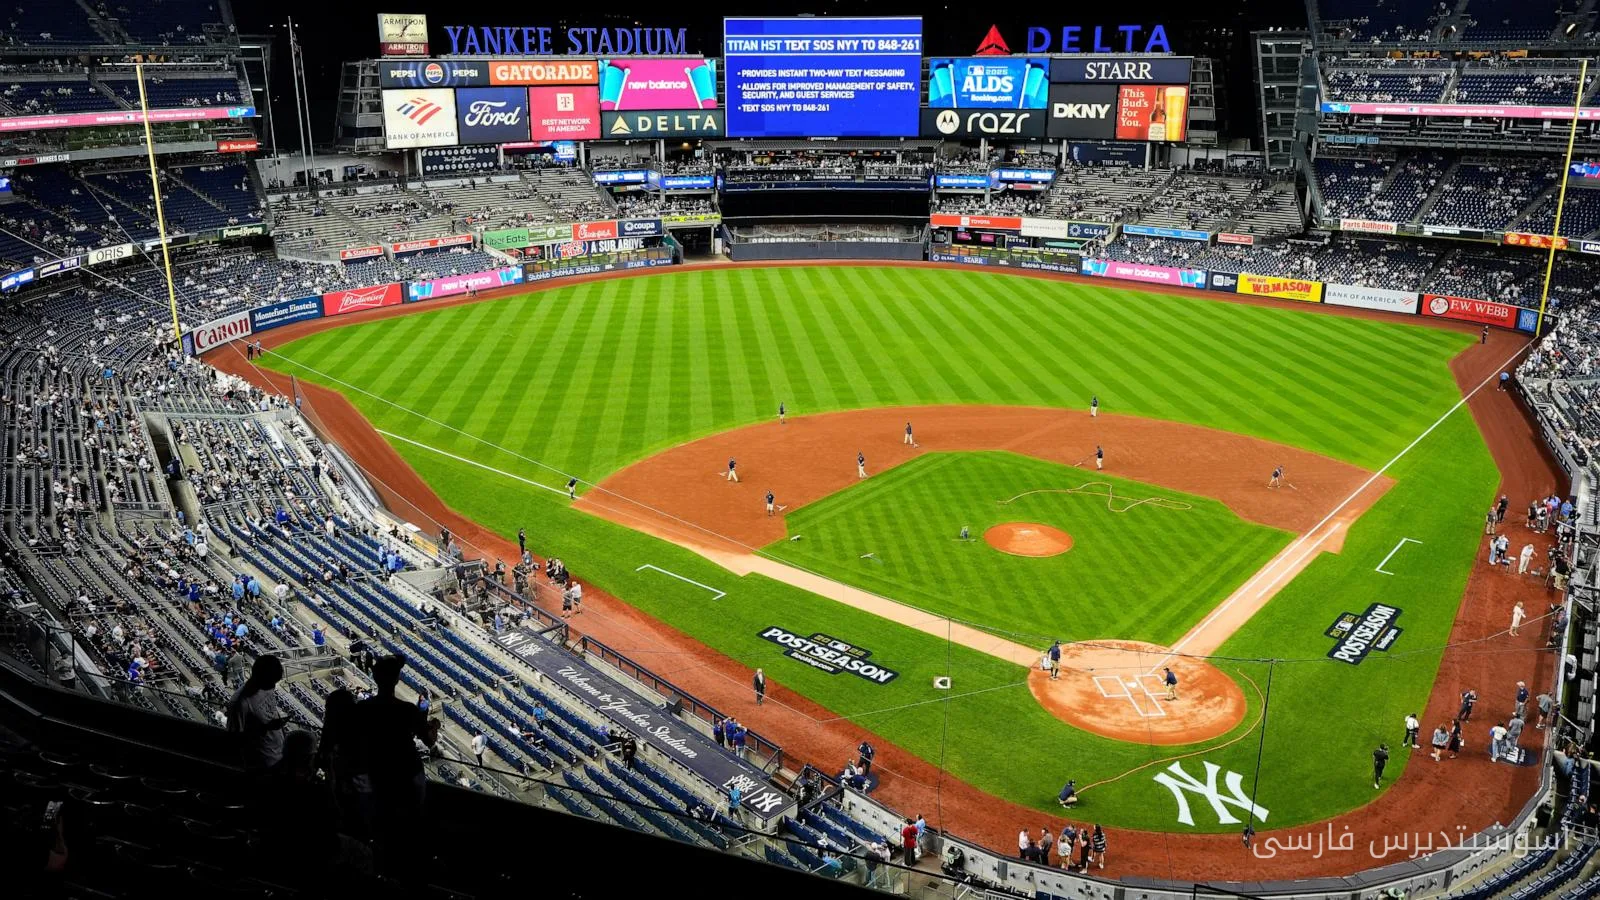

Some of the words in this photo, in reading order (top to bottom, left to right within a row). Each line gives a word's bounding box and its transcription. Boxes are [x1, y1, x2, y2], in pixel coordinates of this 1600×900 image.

[384, 18, 424, 26] ARMITRON
[445, 25, 553, 55] YANKEE
[567, 27, 688, 55] STADIUM
[727, 40, 757, 51] TITAN
[761, 40, 781, 51] HST
[784, 40, 811, 50] TEXT
[813, 40, 834, 50] SOS
[837, 40, 859, 50] NYY
[861, 40, 875, 50] TO
[878, 40, 920, 50] 848-261
[1027, 25, 1171, 53] DELTA
[390, 70, 416, 78] PEPSI
[452, 69, 478, 77] PEPSI
[495, 64, 593, 81] GATORADE
[742, 69, 777, 77] PROVIDES
[778, 69, 808, 77] INSTANT
[809, 69, 843, 77] TWO-WAY
[845, 69, 862, 77] TEXT
[864, 69, 905, 77] MESSAGING
[1085, 62, 1153, 80] STARR
[628, 81, 648, 89] new
[649, 80, 688, 89] balance
[742, 83, 771, 91] ALLOWS
[887, 82, 915, 91] SAFETY,
[961, 75, 1013, 93] ALDS
[742, 91, 779, 100] SECURITY,
[780, 91, 795, 99] AND
[796, 91, 819, 99] GUEST
[820, 91, 855, 99] SERVICES
[971, 94, 1013, 103] Booking.com
[1122, 88, 1145, 98] This
[742, 104, 759, 112] TEXT
[1122, 98, 1149, 108] Bud's
[464, 100, 521, 127] Ford
[1053, 103, 1111, 119] DKNY
[1121, 108, 1138, 117] For
[637, 114, 718, 132] DELTA
[967, 112, 1030, 134] razr
[1121, 117, 1142, 127] You.
[388, 133, 408, 141] BANK
[422, 131, 455, 139] AMERICA
[223, 227, 243, 239] Poland
[243, 226, 263, 237] Spring
[633, 222, 655, 231] coupa
[1083, 228, 1108, 236] CLEAR
[1342, 221, 1360, 229] Parts
[1361, 221, 1394, 232] Authority
[506, 234, 526, 244] Eats
[590, 243, 598, 253] A
[599, 239, 615, 252] SUB
[615, 238, 644, 251] ABOVE
[96, 246, 124, 262] ORIS
[528, 272, 551, 281] StubHub
[551, 269, 575, 278] StubHub
[576, 266, 600, 275] StubHub
[1115, 266, 1134, 275] new
[1134, 267, 1170, 280] balance
[441, 280, 458, 291] new
[459, 275, 492, 288] balance
[344, 293, 384, 307] Budweiser
[1327, 291, 1348, 299] BANK
[1361, 295, 1397, 305] AMERICA
[254, 308, 288, 322] Montefiore
[289, 301, 318, 312] Einstein
[1450, 300, 1471, 311] F.W.
[1475, 303, 1509, 318] WEBB
[195, 317, 250, 349] Canon
[498, 632, 524, 645] NY
[1333, 604, 1397, 663] POSTSEASON
[815, 634, 831, 644] 20
[848, 646, 866, 657] 25
[762, 627, 894, 683] POSTSEASON
[791, 651, 834, 673] Booking.com
[557, 665, 600, 697] Welcome
[598, 693, 612, 703] to
[600, 697, 651, 728] Yankee
[647, 725, 698, 760] Stadium
[1153, 760, 1270, 827] NY
[750, 792, 783, 813] NY
